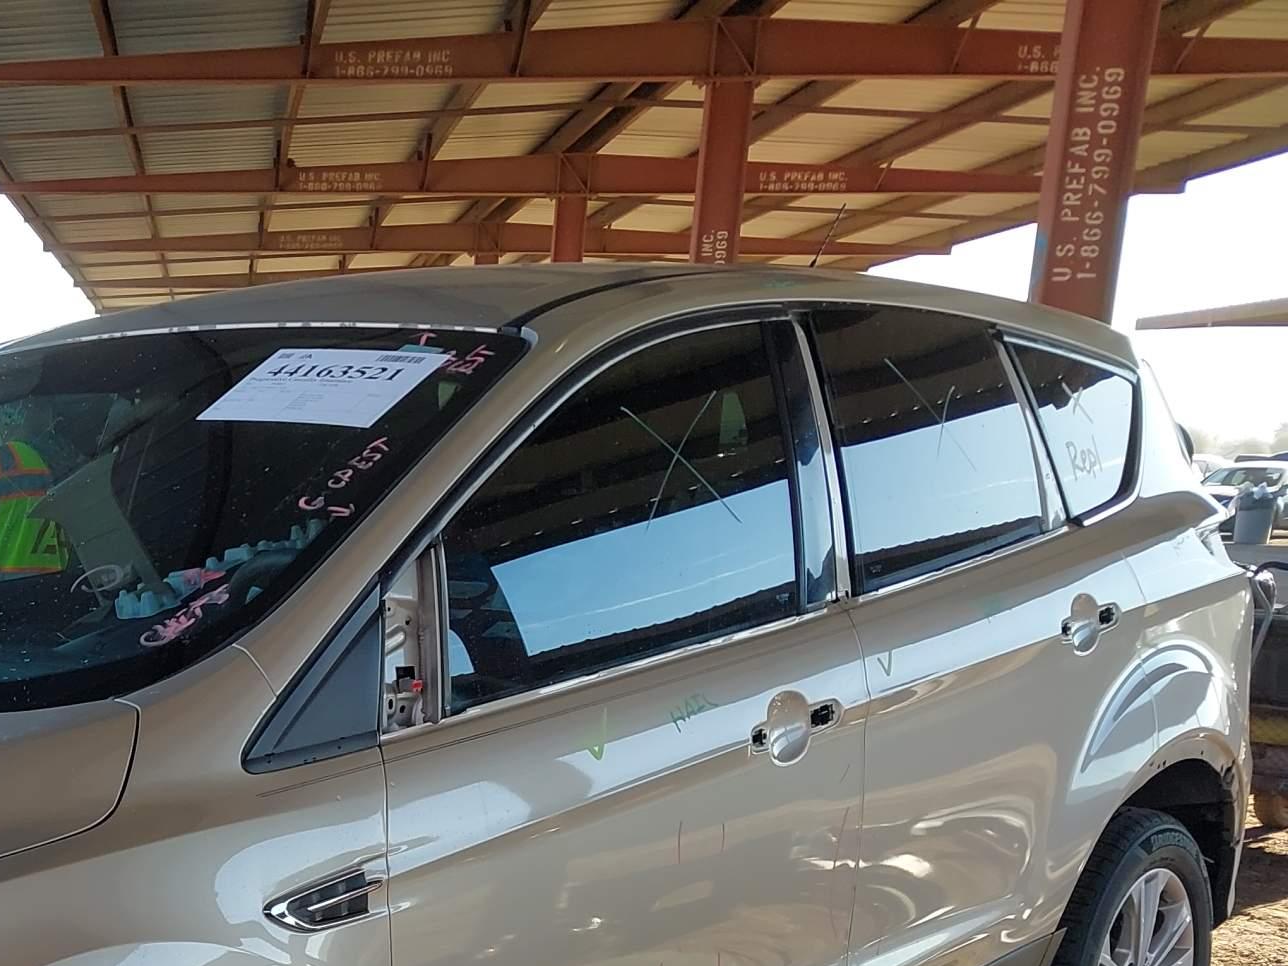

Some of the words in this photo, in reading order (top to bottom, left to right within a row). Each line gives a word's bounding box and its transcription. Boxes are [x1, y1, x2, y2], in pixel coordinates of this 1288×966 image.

[1075, 66, 1101, 113] INC.
[1060, 126, 1092, 222] PREFAB
[1076, 67, 1126, 279] 1-866-799-0969
[266, 363, 406, 382] 44163521
